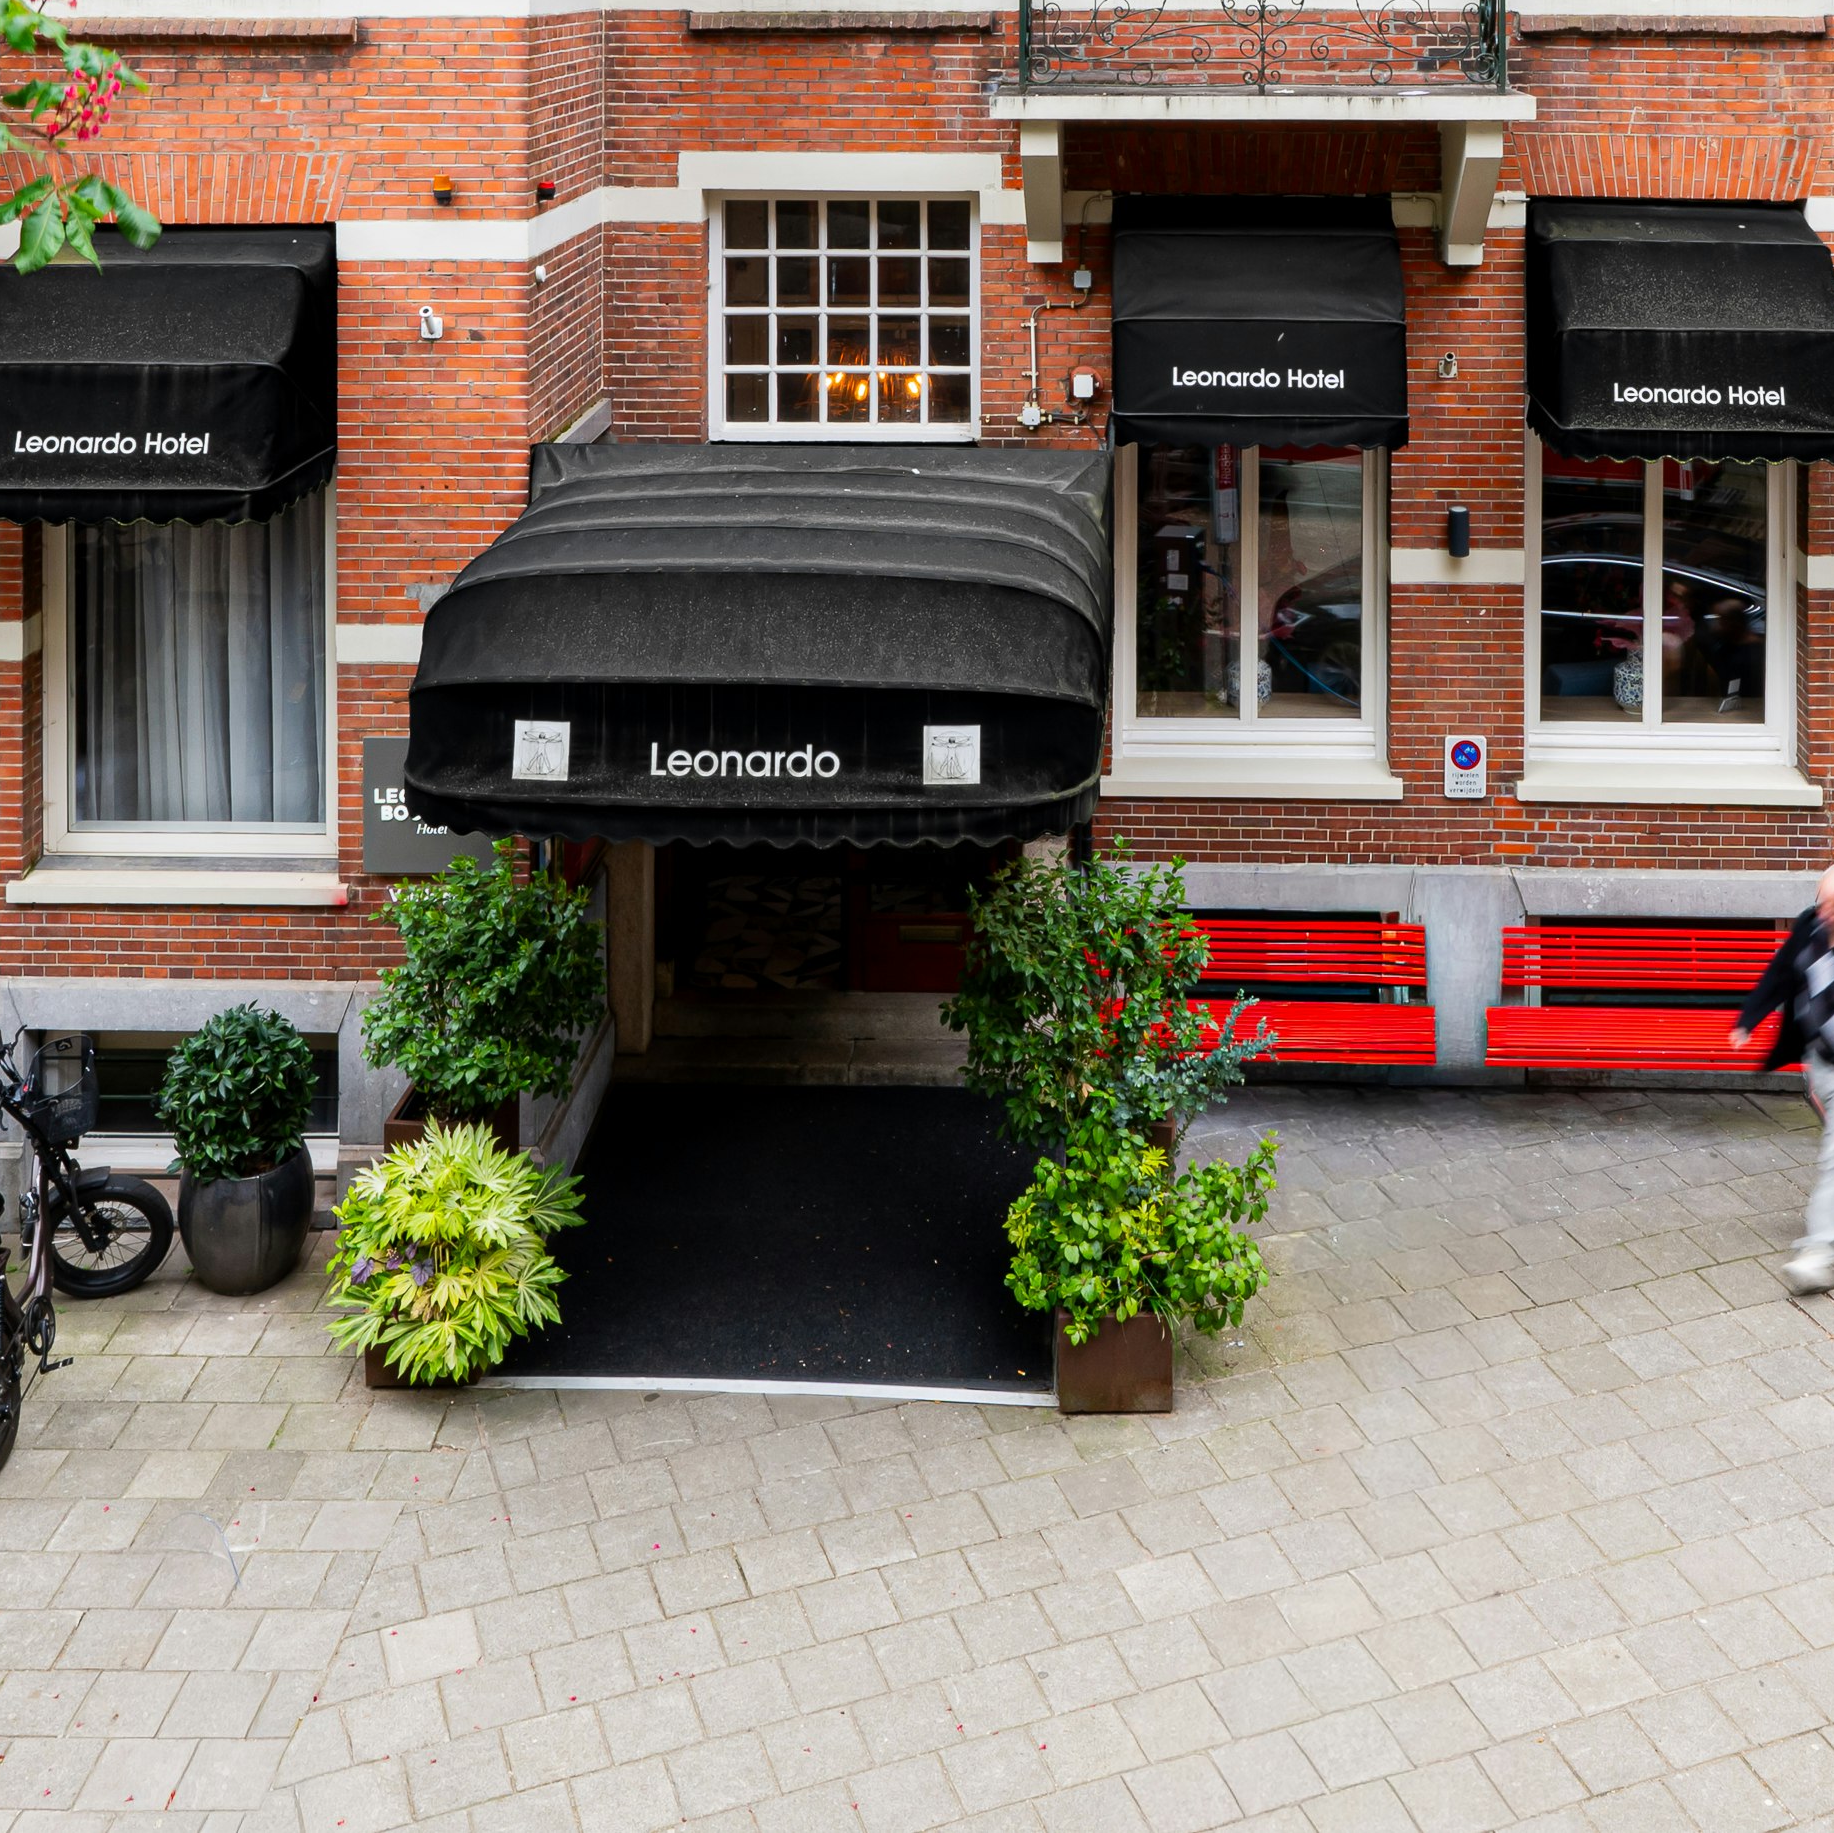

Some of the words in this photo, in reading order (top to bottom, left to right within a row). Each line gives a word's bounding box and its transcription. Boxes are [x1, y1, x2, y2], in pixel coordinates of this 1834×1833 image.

[1172, 366, 1282, 388] Leonardo
[1287, 368, 1345, 390] Hotel
[1613, 382, 1723, 406] Leonardo
[1728, 385, 1787, 407] Hotel
[14, 430, 138, 455] Leonardo
[143, 432, 211, 456] Hotel
[649, 741, 842, 779] Leonardo
